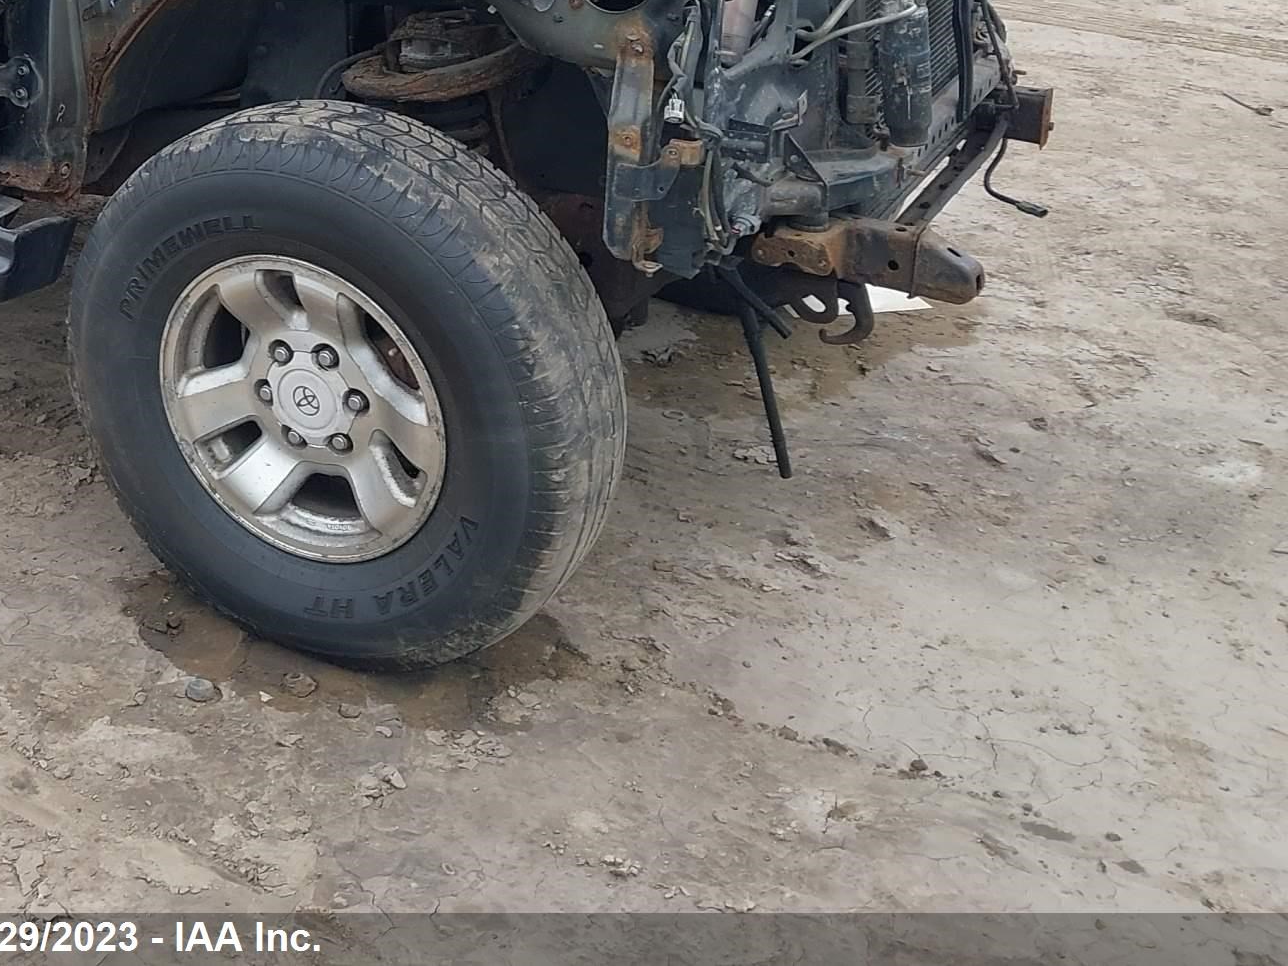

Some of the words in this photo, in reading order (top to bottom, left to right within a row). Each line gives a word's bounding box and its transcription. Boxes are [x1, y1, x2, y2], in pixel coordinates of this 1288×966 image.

[119, 214, 264, 322] PRIMEWELL
[303, 595, 355, 619] HT
[372, 515, 480, 616] VALERA
